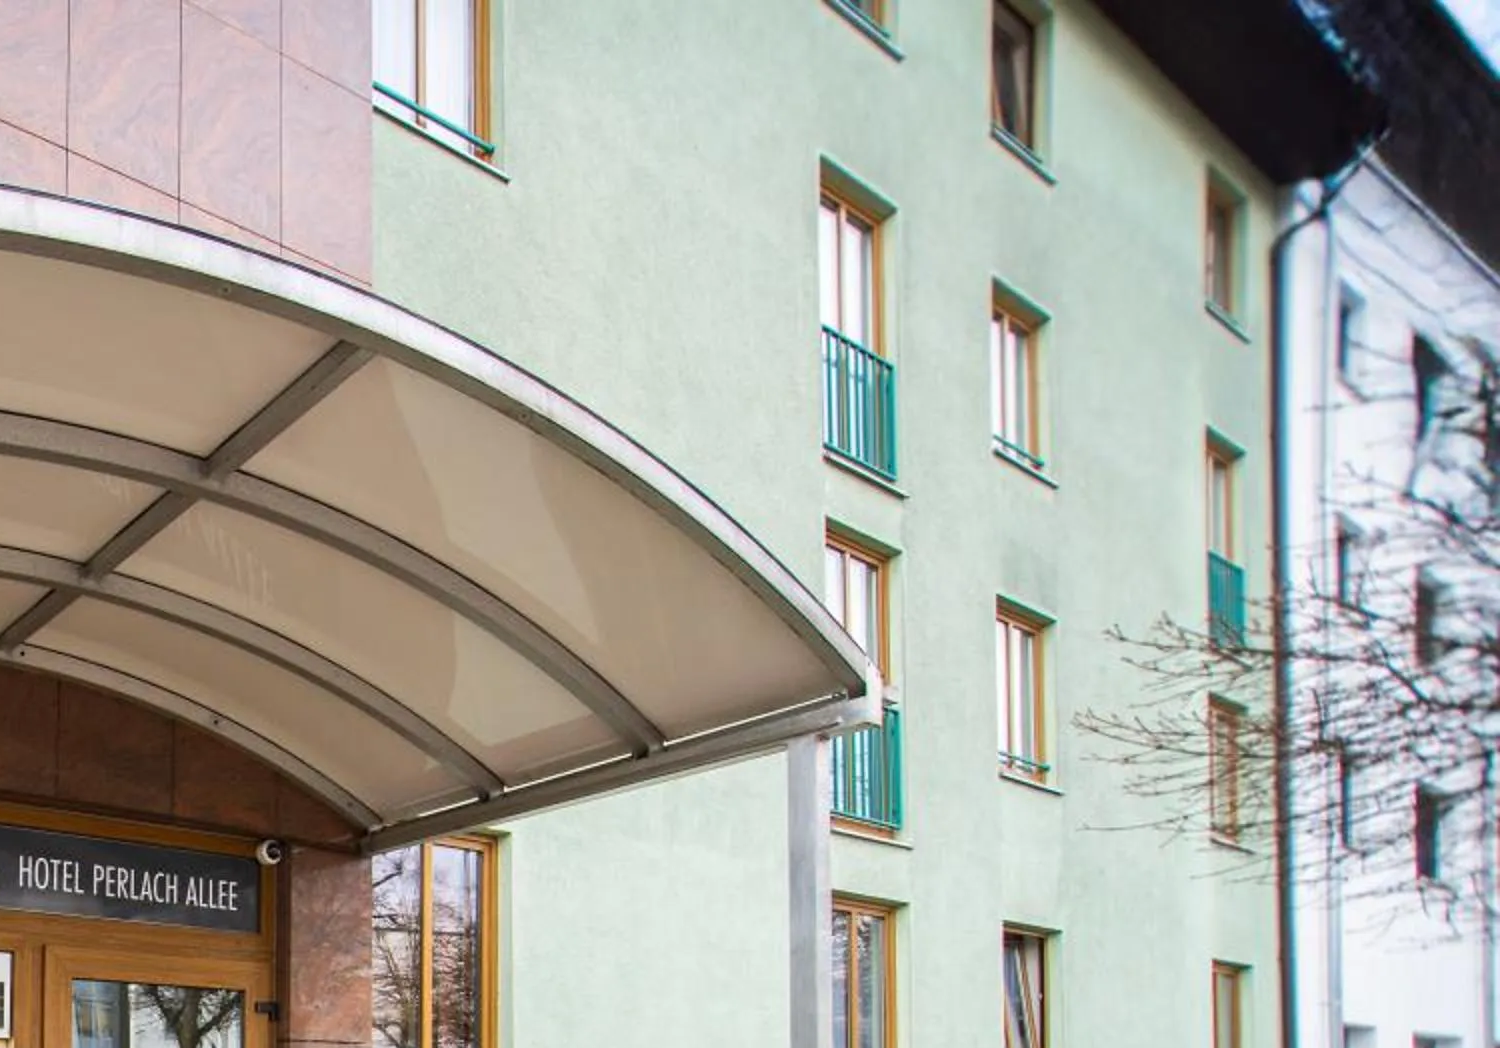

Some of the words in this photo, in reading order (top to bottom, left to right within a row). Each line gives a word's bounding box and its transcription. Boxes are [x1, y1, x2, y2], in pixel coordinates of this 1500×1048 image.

[18, 855, 84, 894] HOTEL
[92, 864, 179, 905] PERLACH
[185, 876, 239, 911] ALLEE
